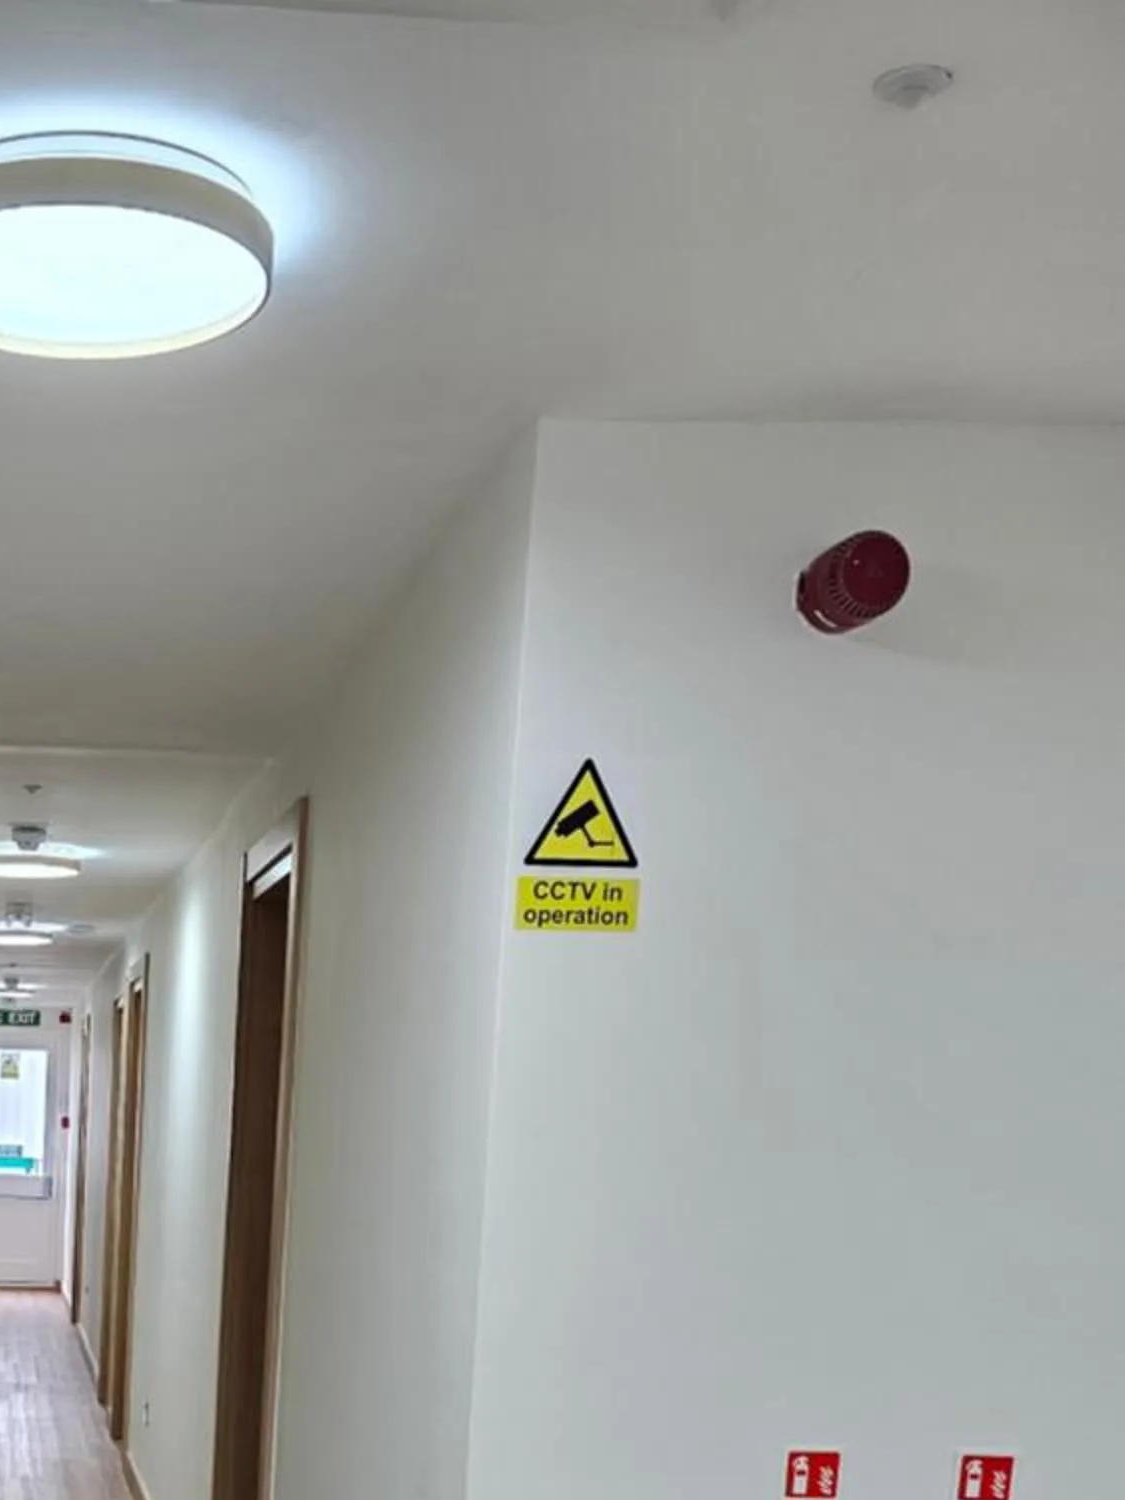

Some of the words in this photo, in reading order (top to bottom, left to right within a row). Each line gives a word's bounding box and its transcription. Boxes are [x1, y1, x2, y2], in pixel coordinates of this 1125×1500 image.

[533, 880, 596, 901] CCTV
[603, 884, 623, 901] in
[523, 906, 629, 927] operation
[8, 1010, 36, 1025] EXIT
